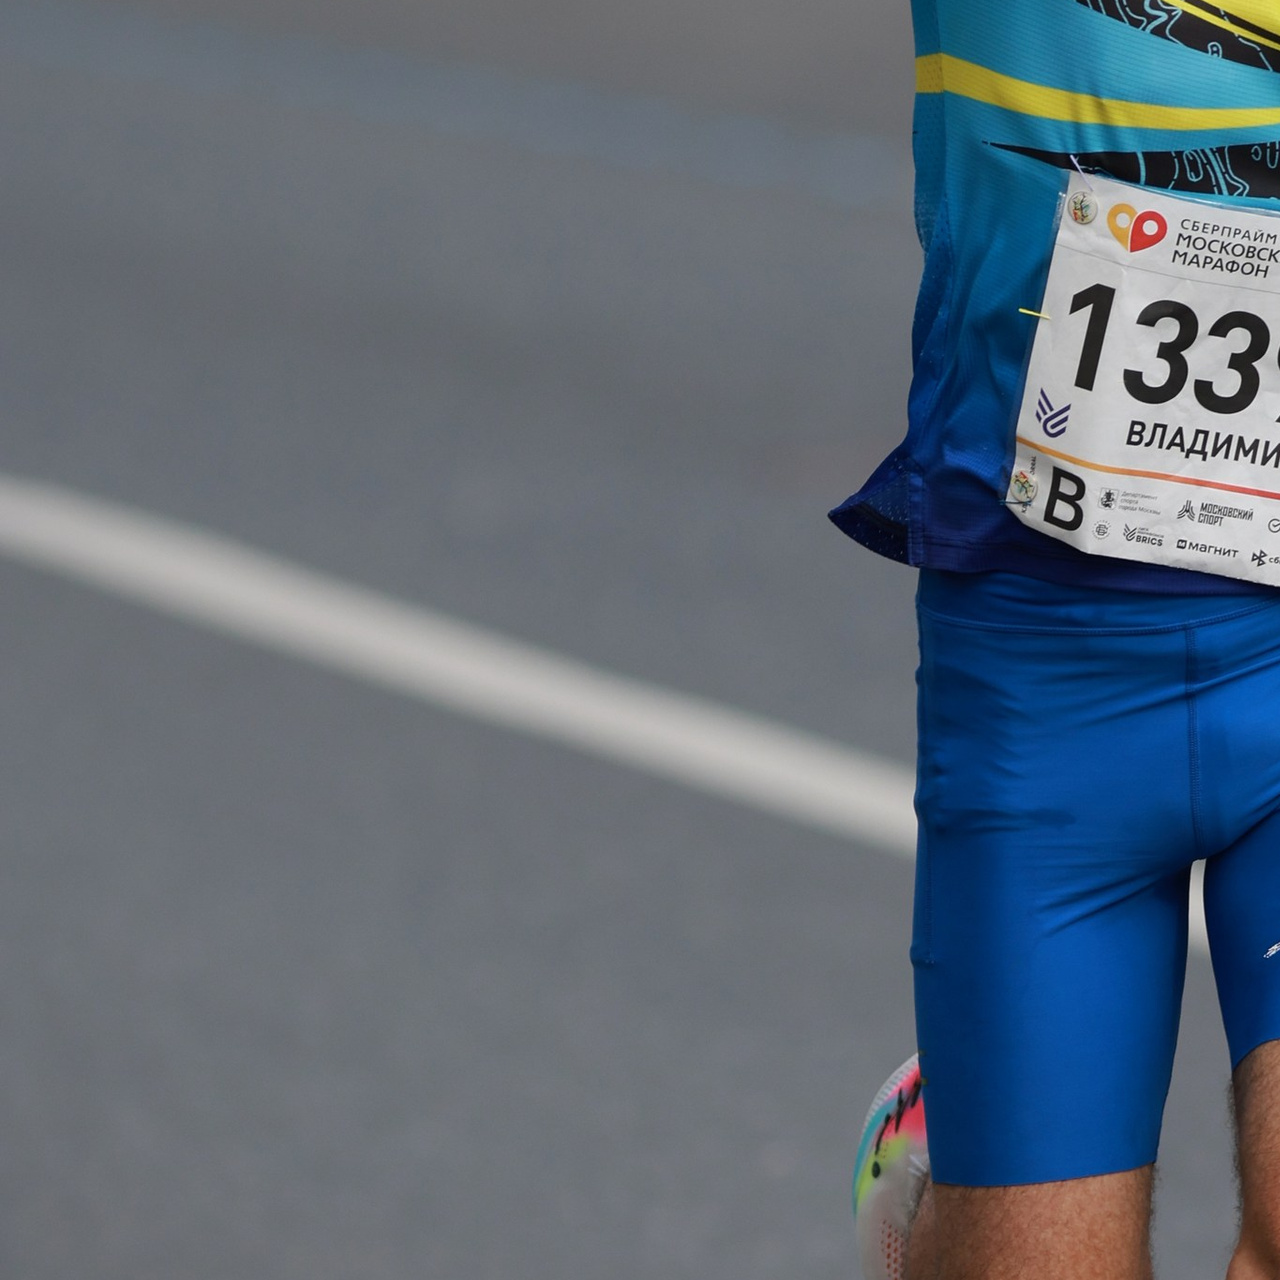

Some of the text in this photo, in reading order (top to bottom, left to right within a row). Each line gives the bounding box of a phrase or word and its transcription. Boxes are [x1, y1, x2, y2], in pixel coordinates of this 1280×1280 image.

[1180, 218, 1279, 245] СБЕРПРАЙМ
[1172, 250, 1270, 278] МАРАФОН
[1198, 513, 1224, 527] СПОРТ
[1200, 502, 1254, 521] МОСКОВСКИЙ
[1135, 535, 1164, 547] BRICS
[1188, 541, 1239, 558] магнит
